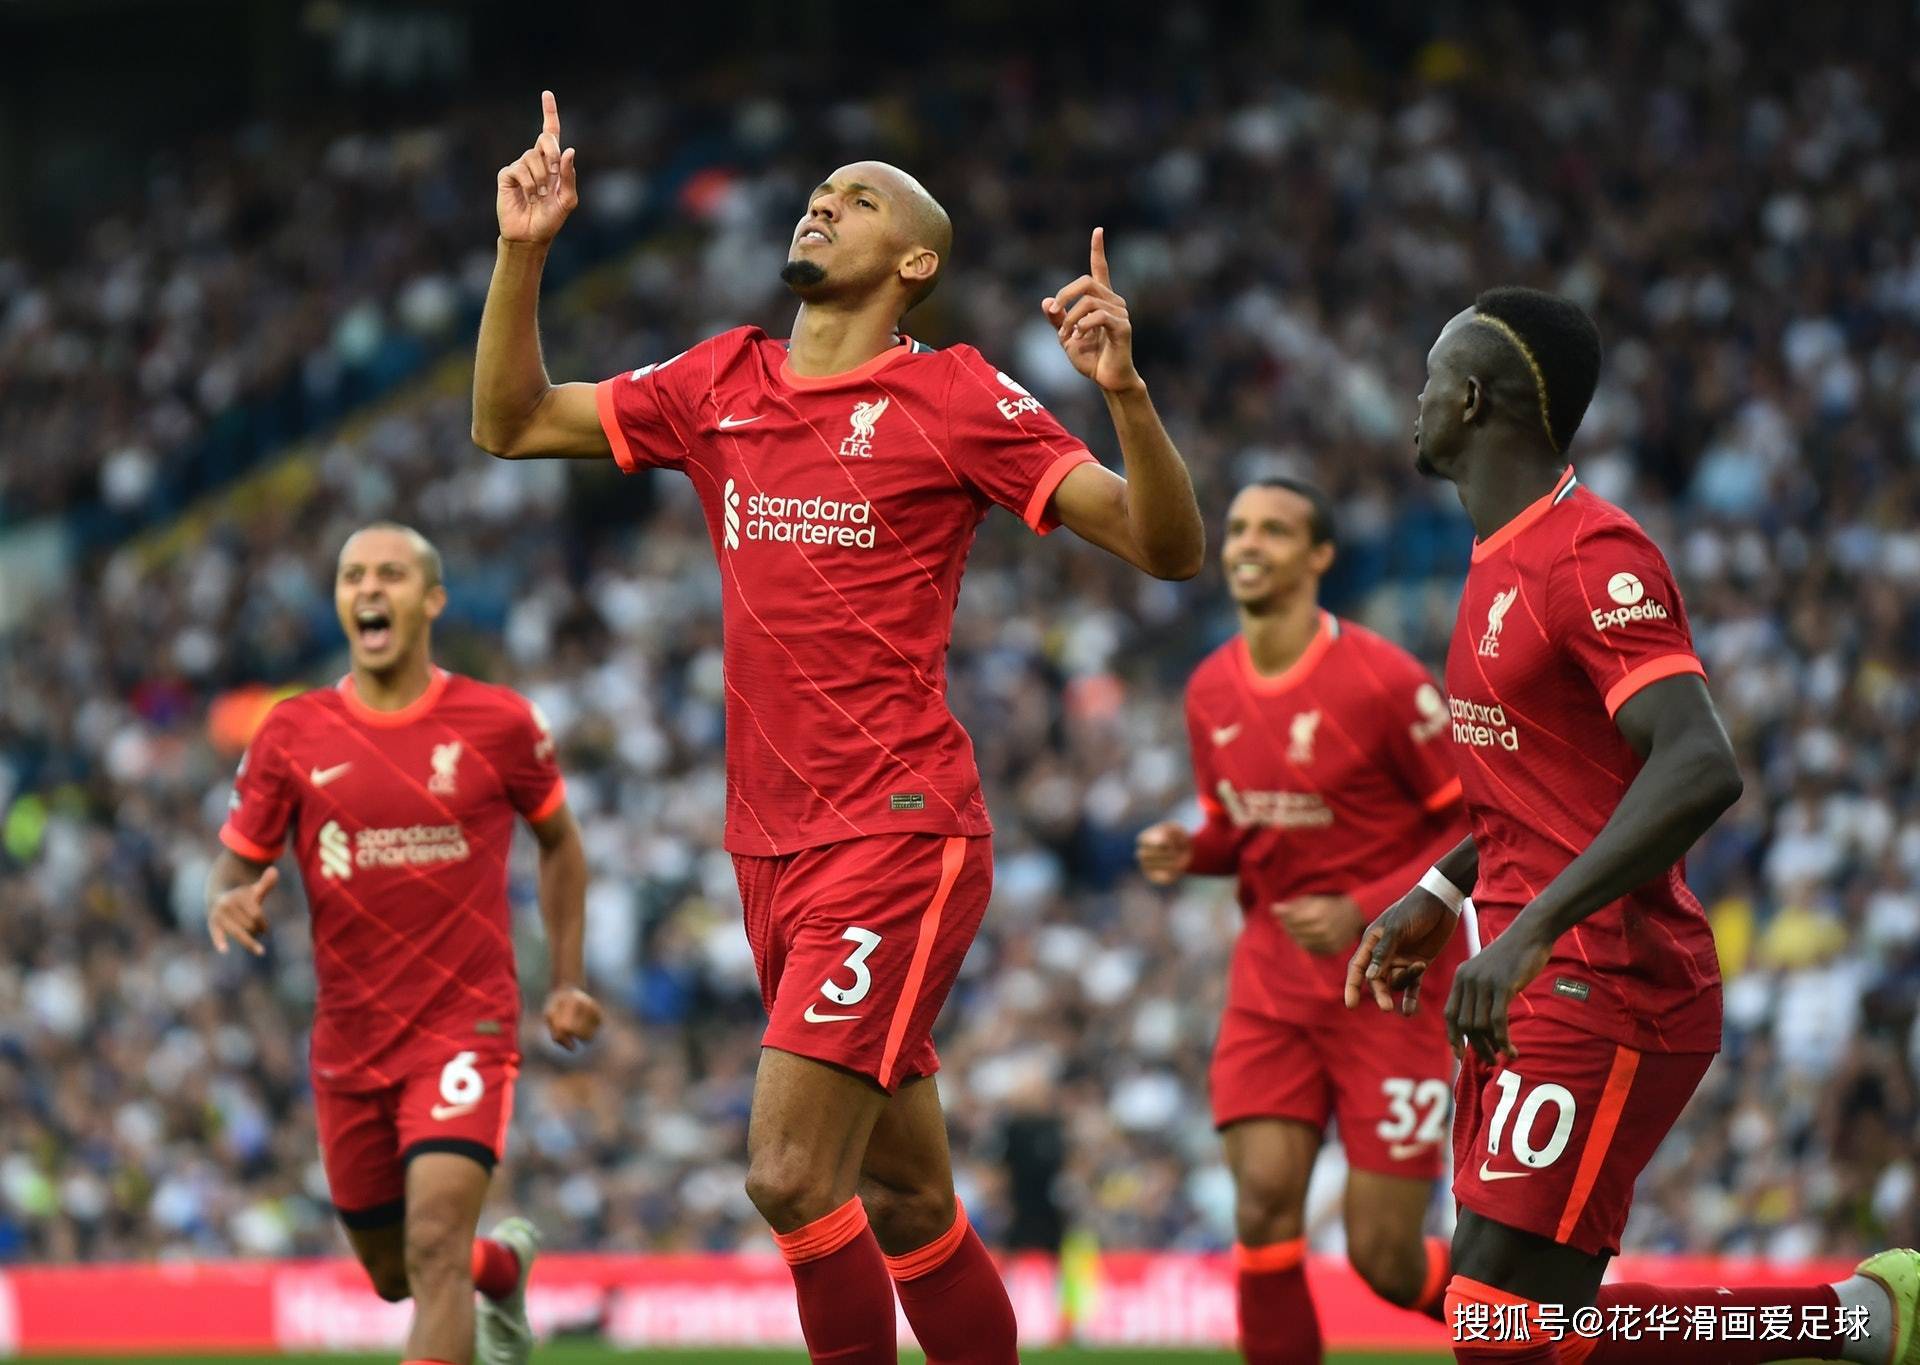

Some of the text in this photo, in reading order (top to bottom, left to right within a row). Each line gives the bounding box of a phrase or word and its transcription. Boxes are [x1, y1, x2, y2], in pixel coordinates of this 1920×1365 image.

[745, 516, 876, 549] chartered
[746, 491, 870, 524] standard
[1590, 598, 1668, 632] Expedia
[820, 925, 883, 1005] 3
[439, 1051, 485, 1105] 6
[1376, 1077, 1450, 1141] 32
[1487, 1068, 1577, 1169] 10
